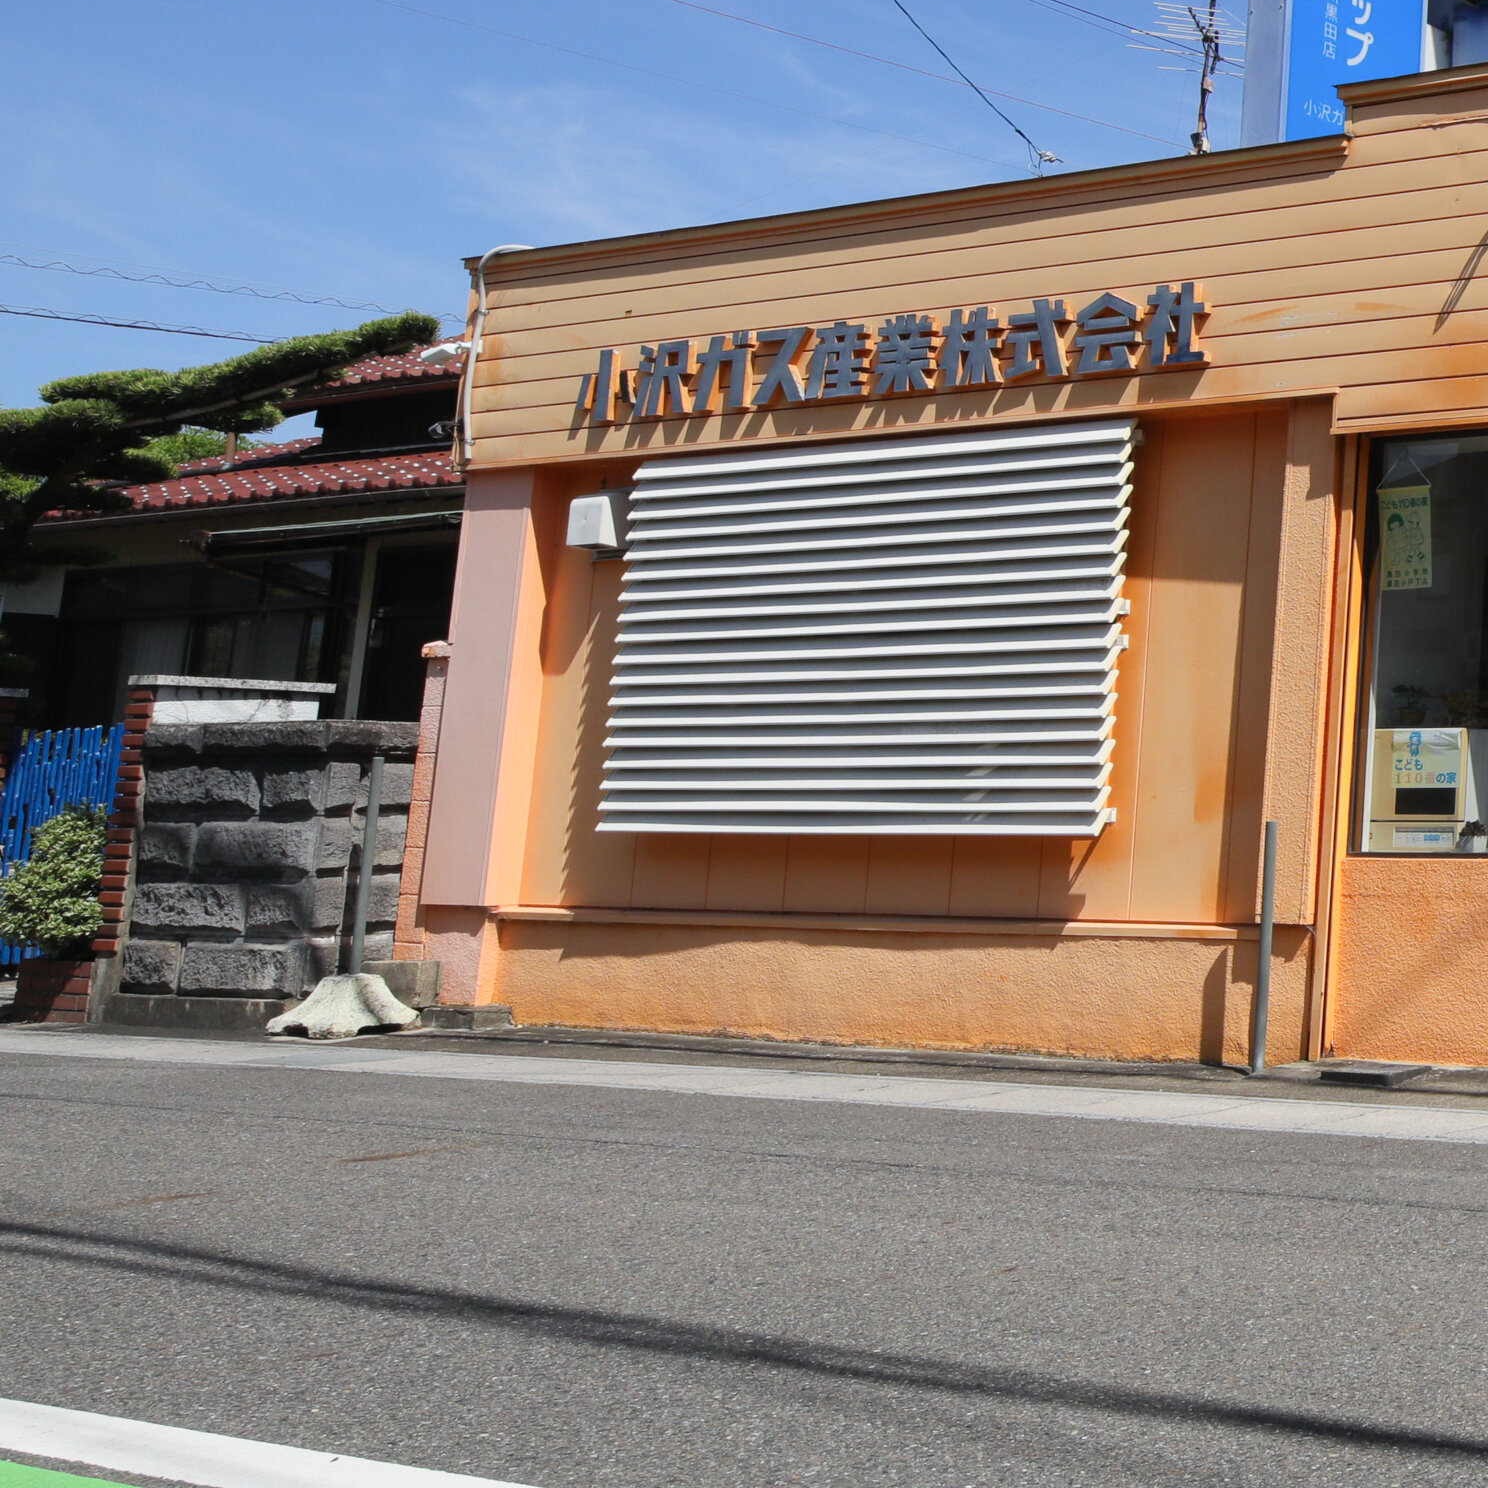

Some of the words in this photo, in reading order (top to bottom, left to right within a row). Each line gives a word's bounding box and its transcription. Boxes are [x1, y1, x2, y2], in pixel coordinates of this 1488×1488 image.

[575, 280, 1214, 423] 小沢ガス産業株式会社
[1394, 758, 1423, 771] こども
[1395, 772, 1457, 785] 110番の家
